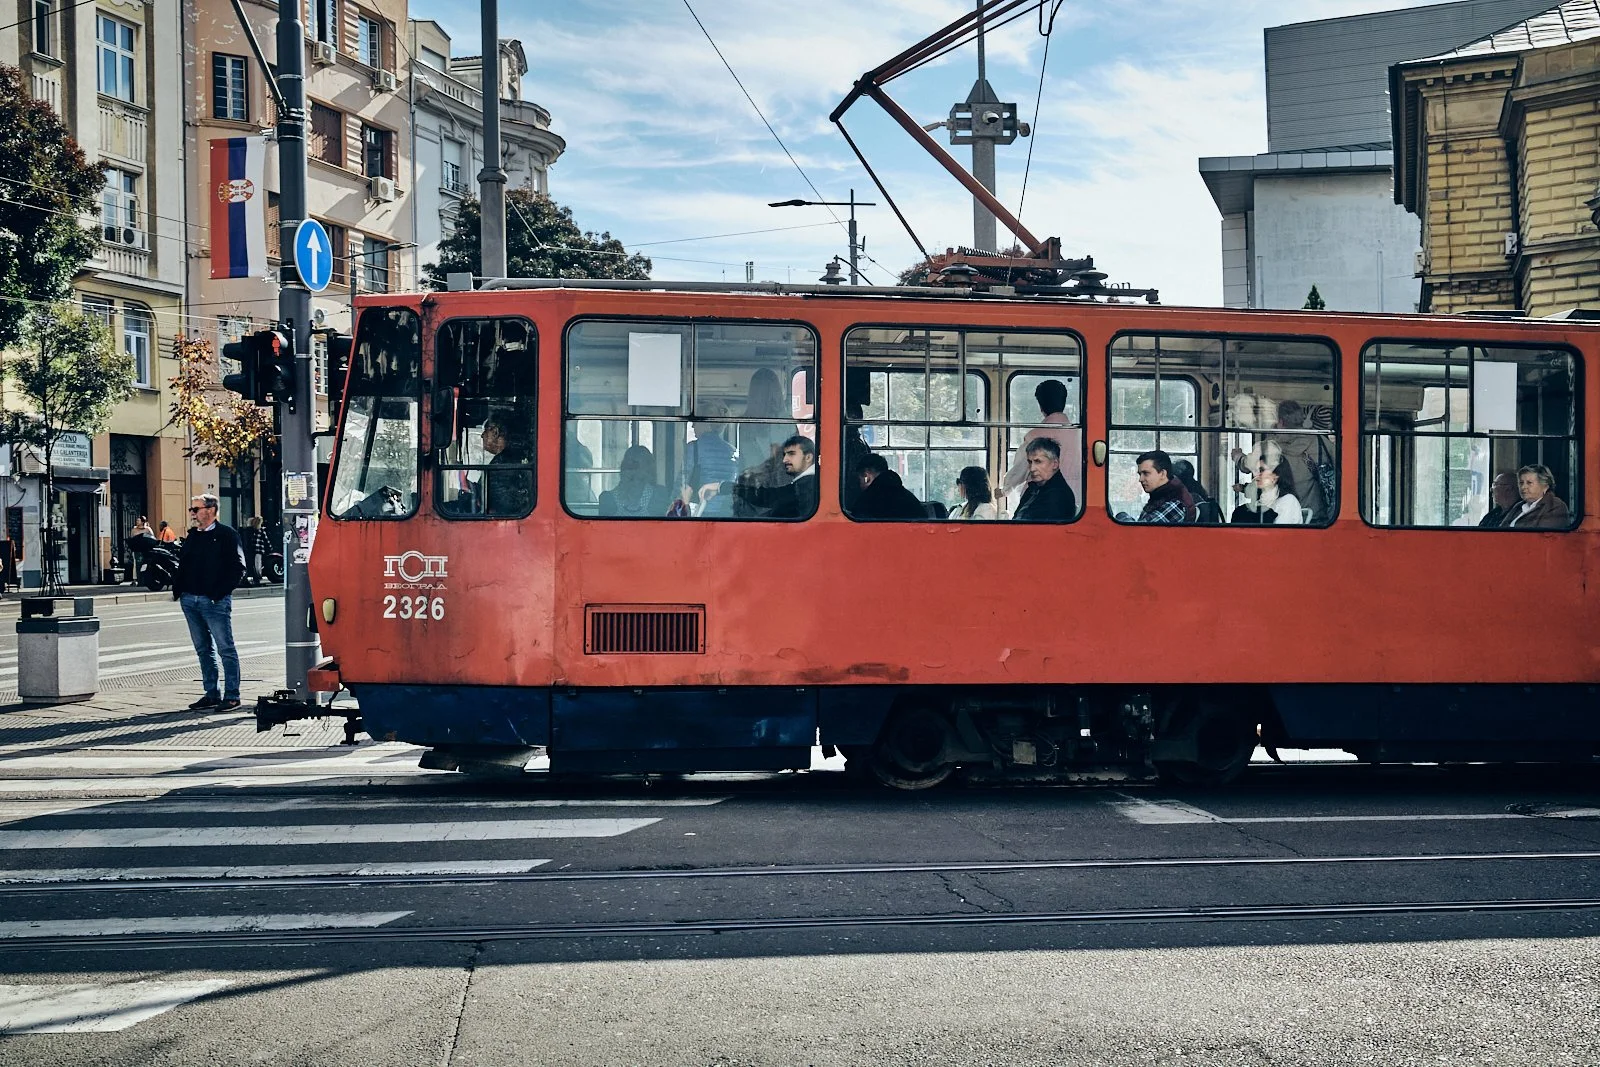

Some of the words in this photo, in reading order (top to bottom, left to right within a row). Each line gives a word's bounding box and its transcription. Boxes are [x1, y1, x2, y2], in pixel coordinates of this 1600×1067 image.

[60, 449, 88, 458] GALANTERIJA
[383, 550, 449, 583] ГСП
[383, 595, 445, 621] 2326
